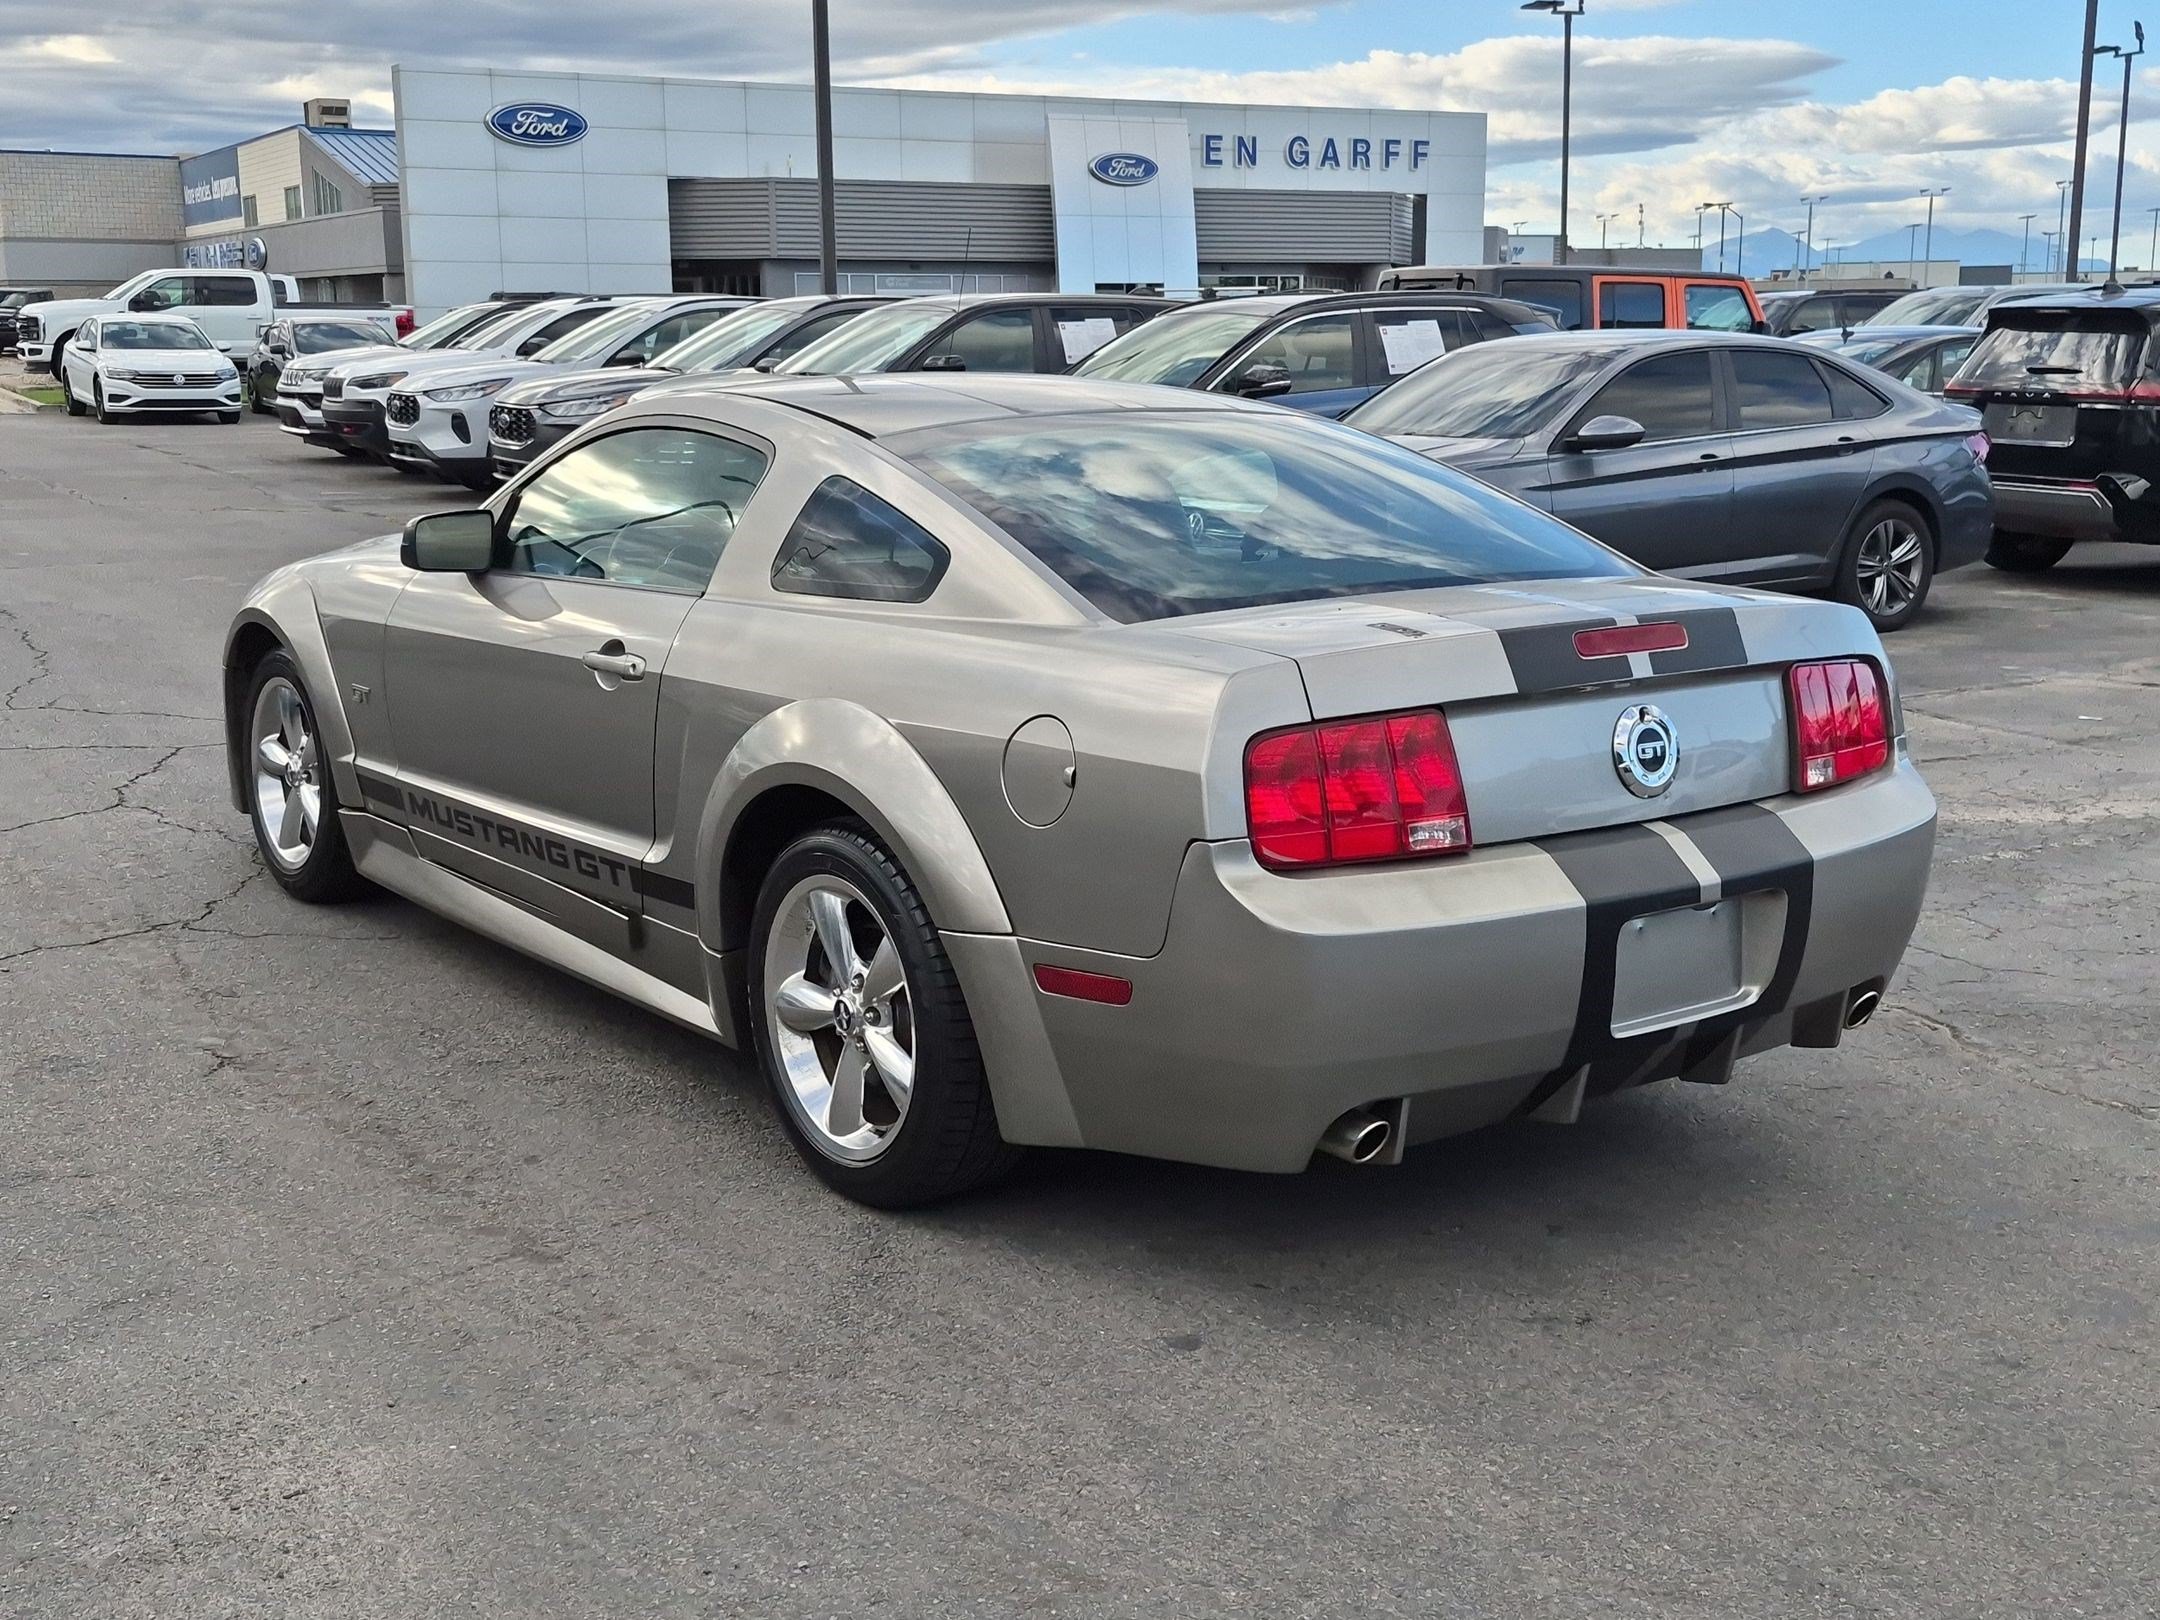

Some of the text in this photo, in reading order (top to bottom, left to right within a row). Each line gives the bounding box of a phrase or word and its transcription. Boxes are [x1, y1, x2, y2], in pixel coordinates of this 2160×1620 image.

[511, 110, 568, 136] Ford
[1202, 133, 1431, 170] EN GARFF
[1108, 158, 1145, 178] Ford
[1637, 740, 1665, 760] GT
[408, 791, 626, 887] MUSTANG GT
